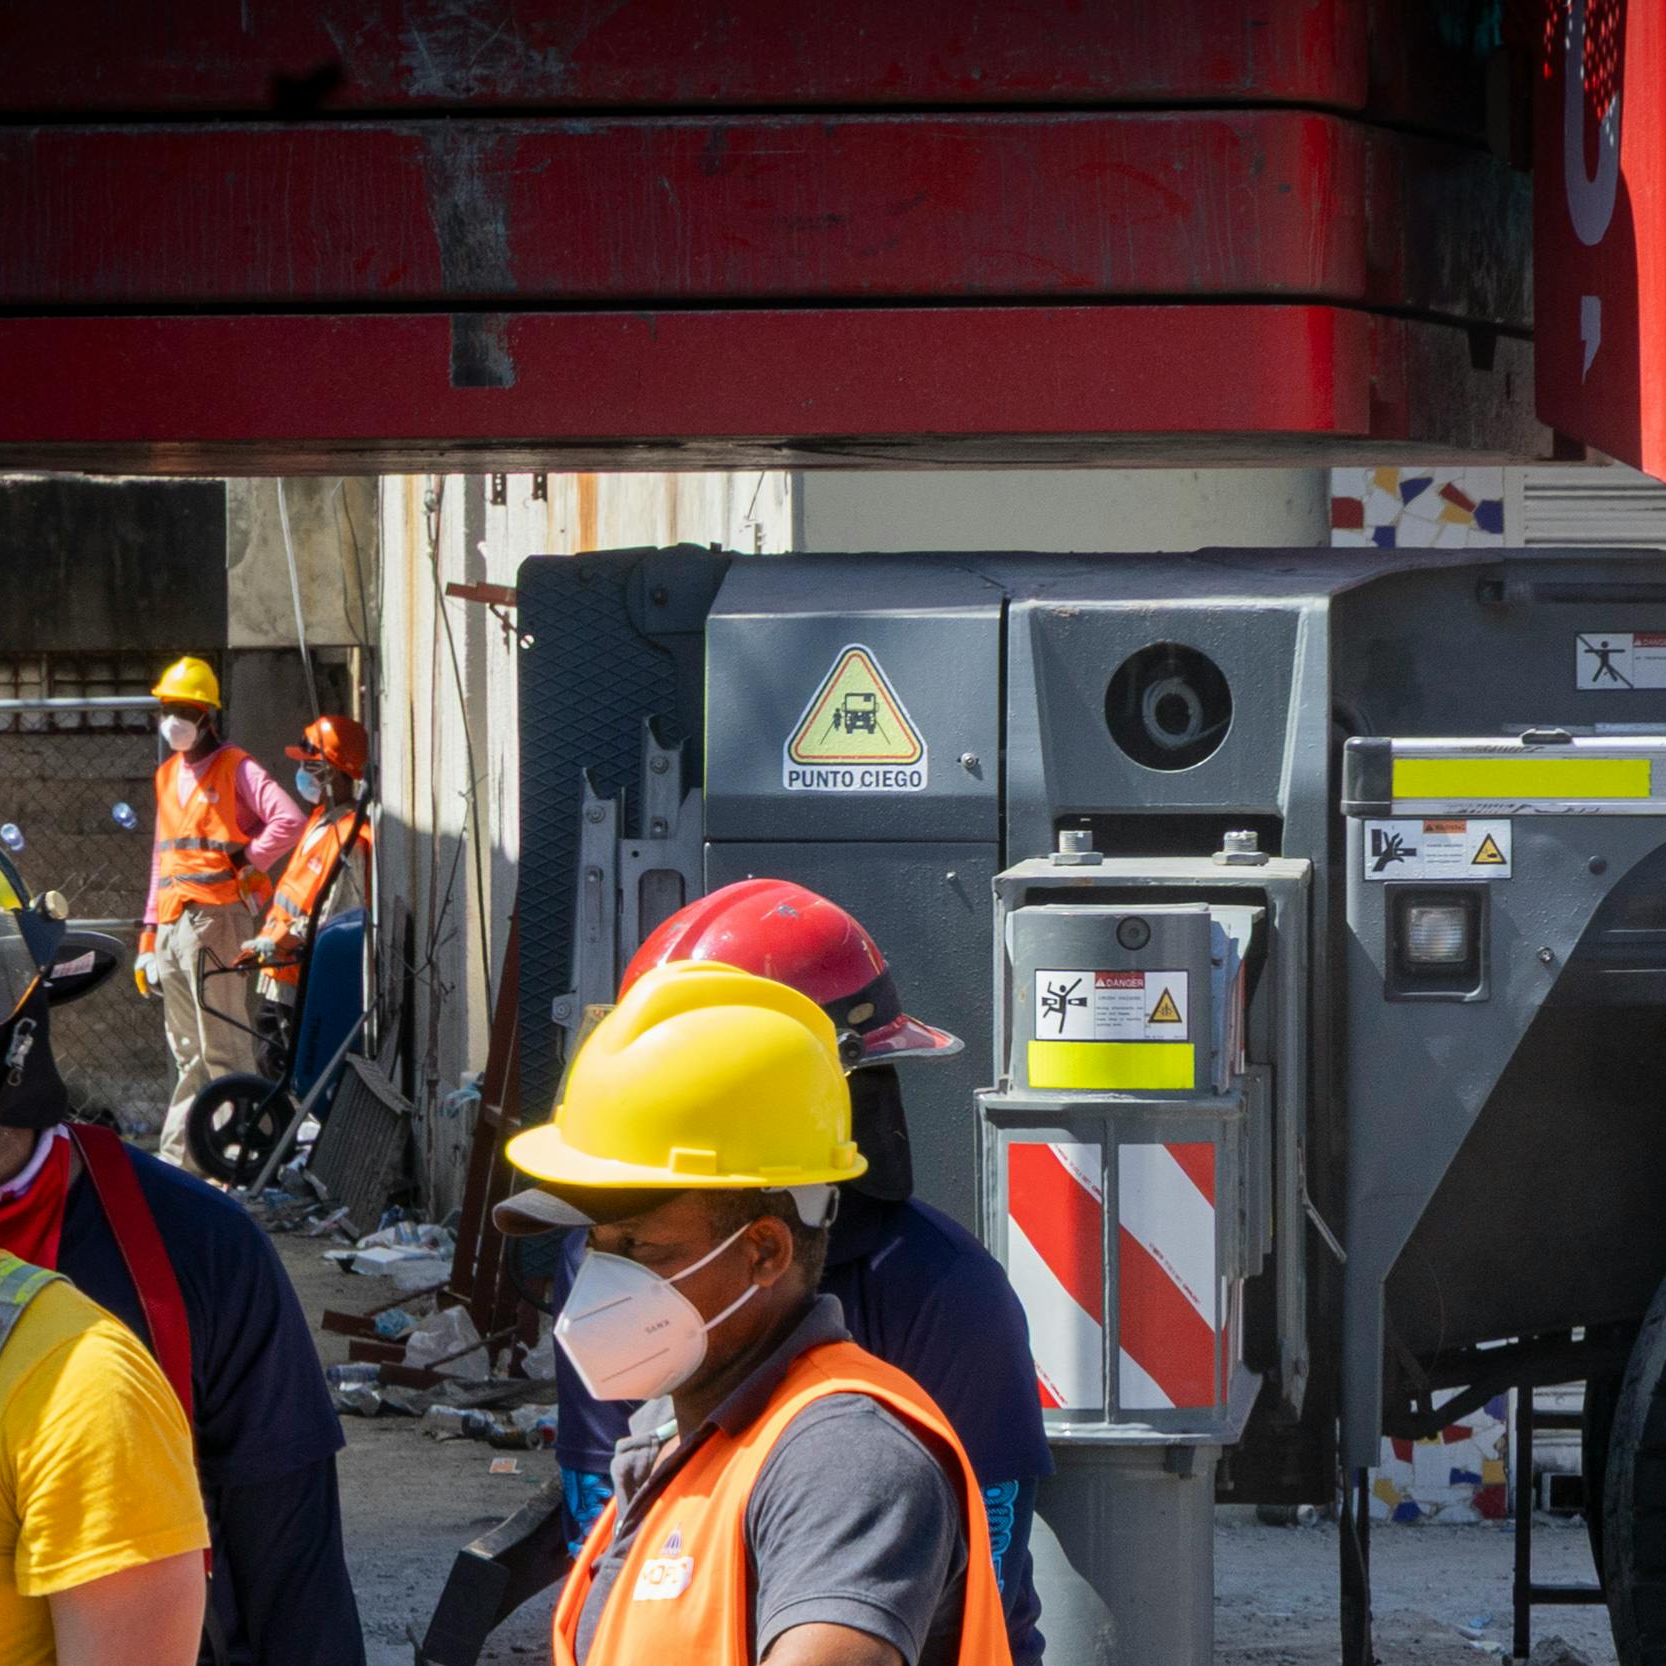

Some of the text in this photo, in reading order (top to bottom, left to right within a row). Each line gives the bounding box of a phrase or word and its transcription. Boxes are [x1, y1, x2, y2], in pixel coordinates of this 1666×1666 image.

[788, 770, 922, 788] PUNTO CIEGO
[1106, 978, 1144, 987] DANGER
